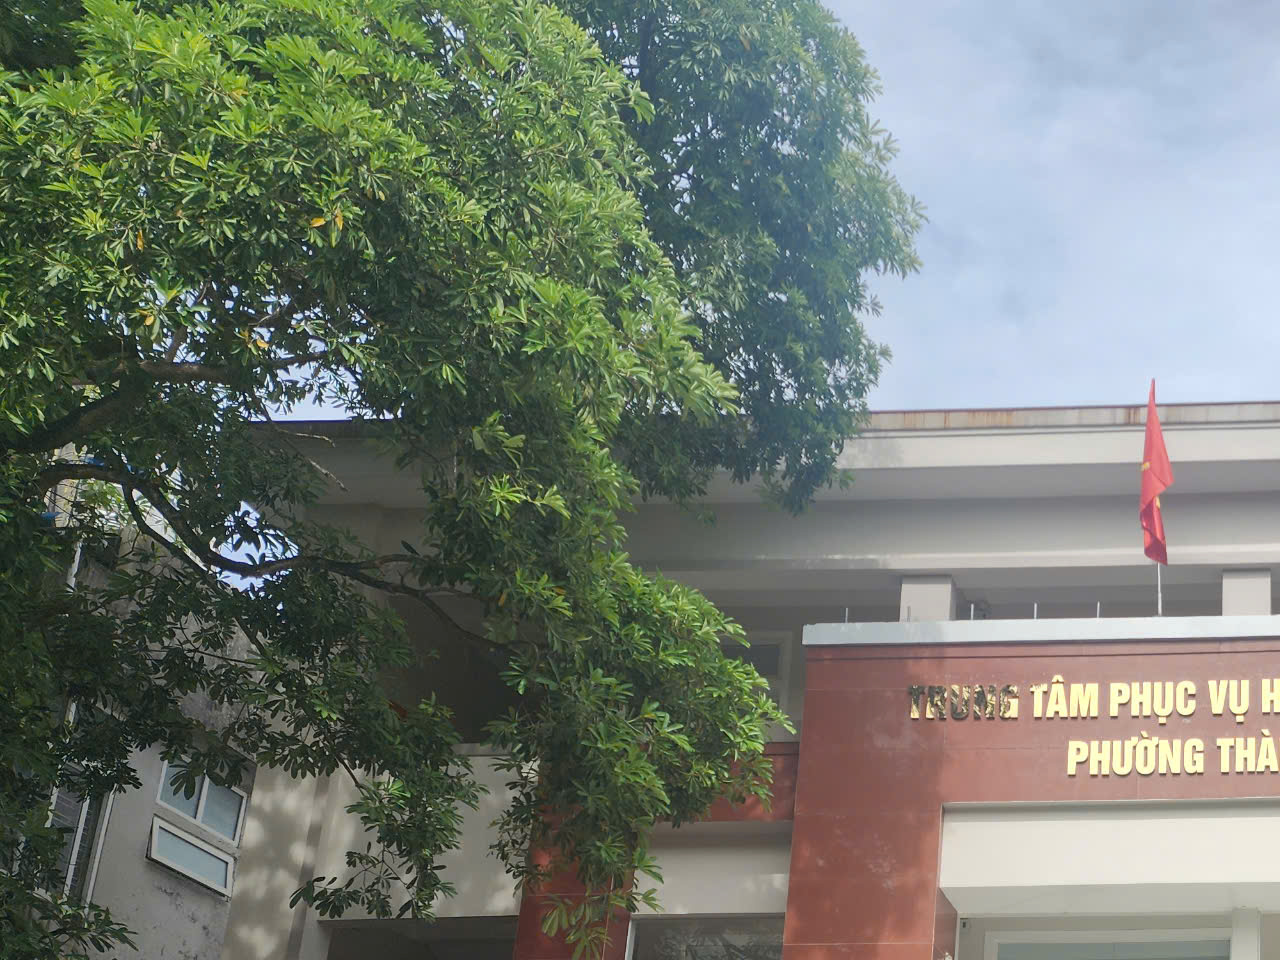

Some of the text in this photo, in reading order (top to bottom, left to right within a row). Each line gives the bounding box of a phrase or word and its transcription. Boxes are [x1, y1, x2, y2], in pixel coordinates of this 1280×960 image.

[909, 684, 1019, 721] TRUNG
[1030, 674, 1099, 719] TÂM
[1109, 680, 1197, 724] PHỤC
[1208, 679, 1250, 723] VỤ
[1067, 731, 1205, 776] PHƯỜNG
